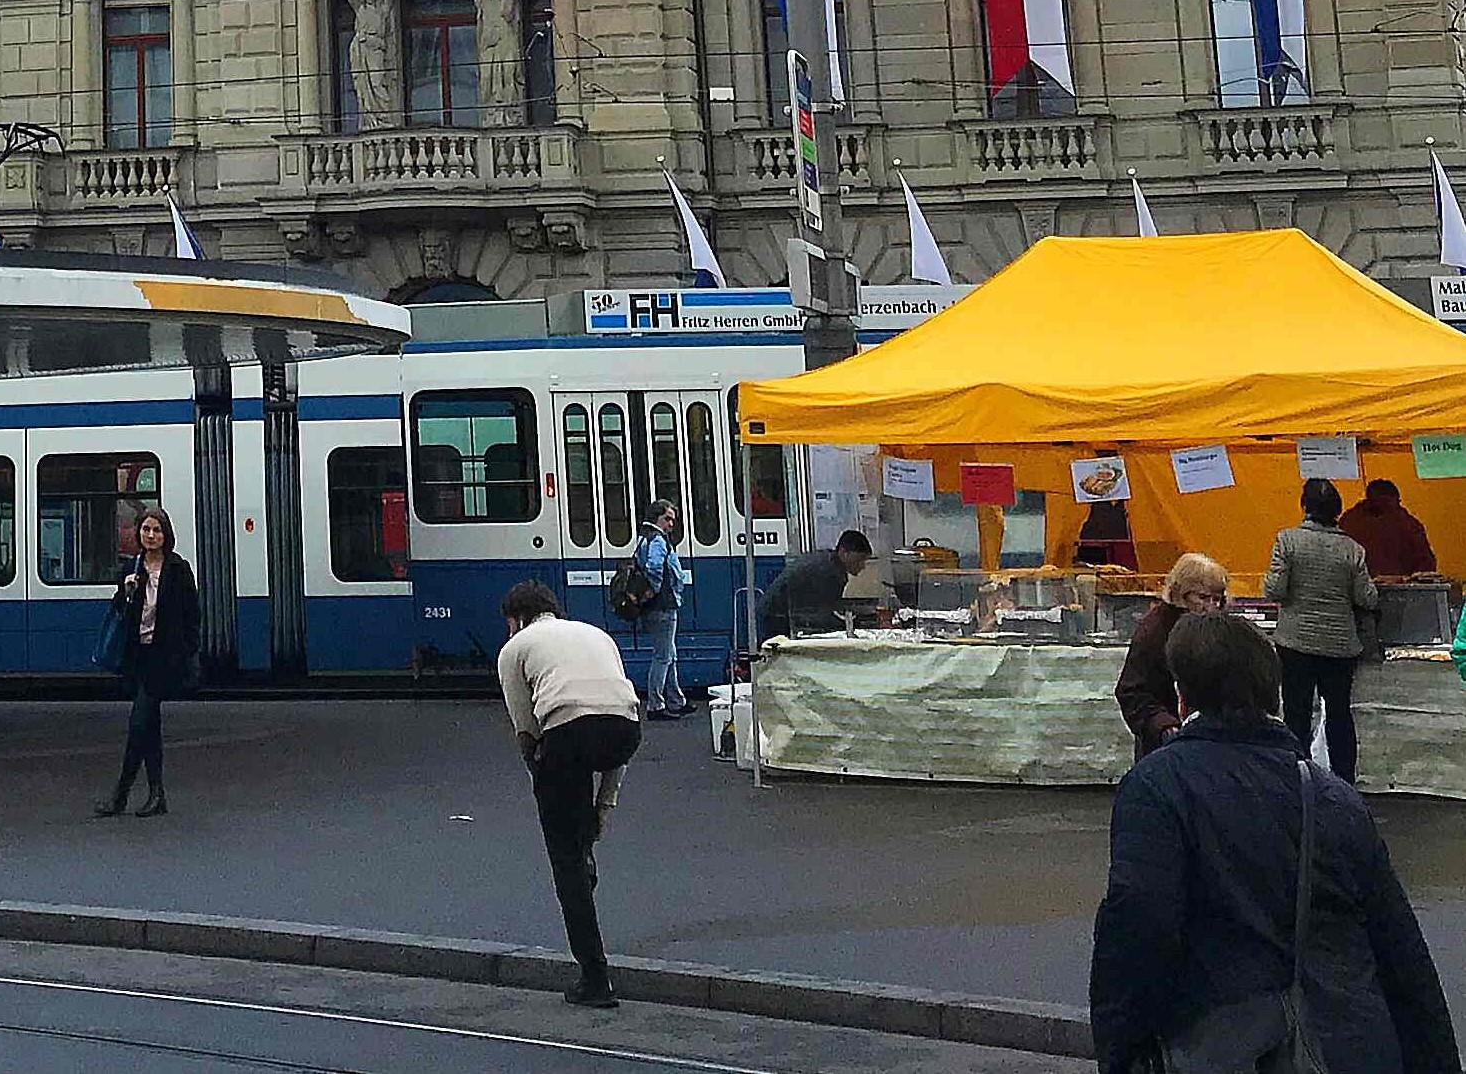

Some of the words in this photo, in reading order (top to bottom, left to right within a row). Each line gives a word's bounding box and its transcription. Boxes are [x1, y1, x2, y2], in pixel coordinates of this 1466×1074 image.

[628, 293, 679, 328] FH
[681, 315, 710, 328] Fritz
[713, 315, 758, 328] Herren
[762, 314, 804, 327] GmbH
[424, 607, 452, 619] 2431
